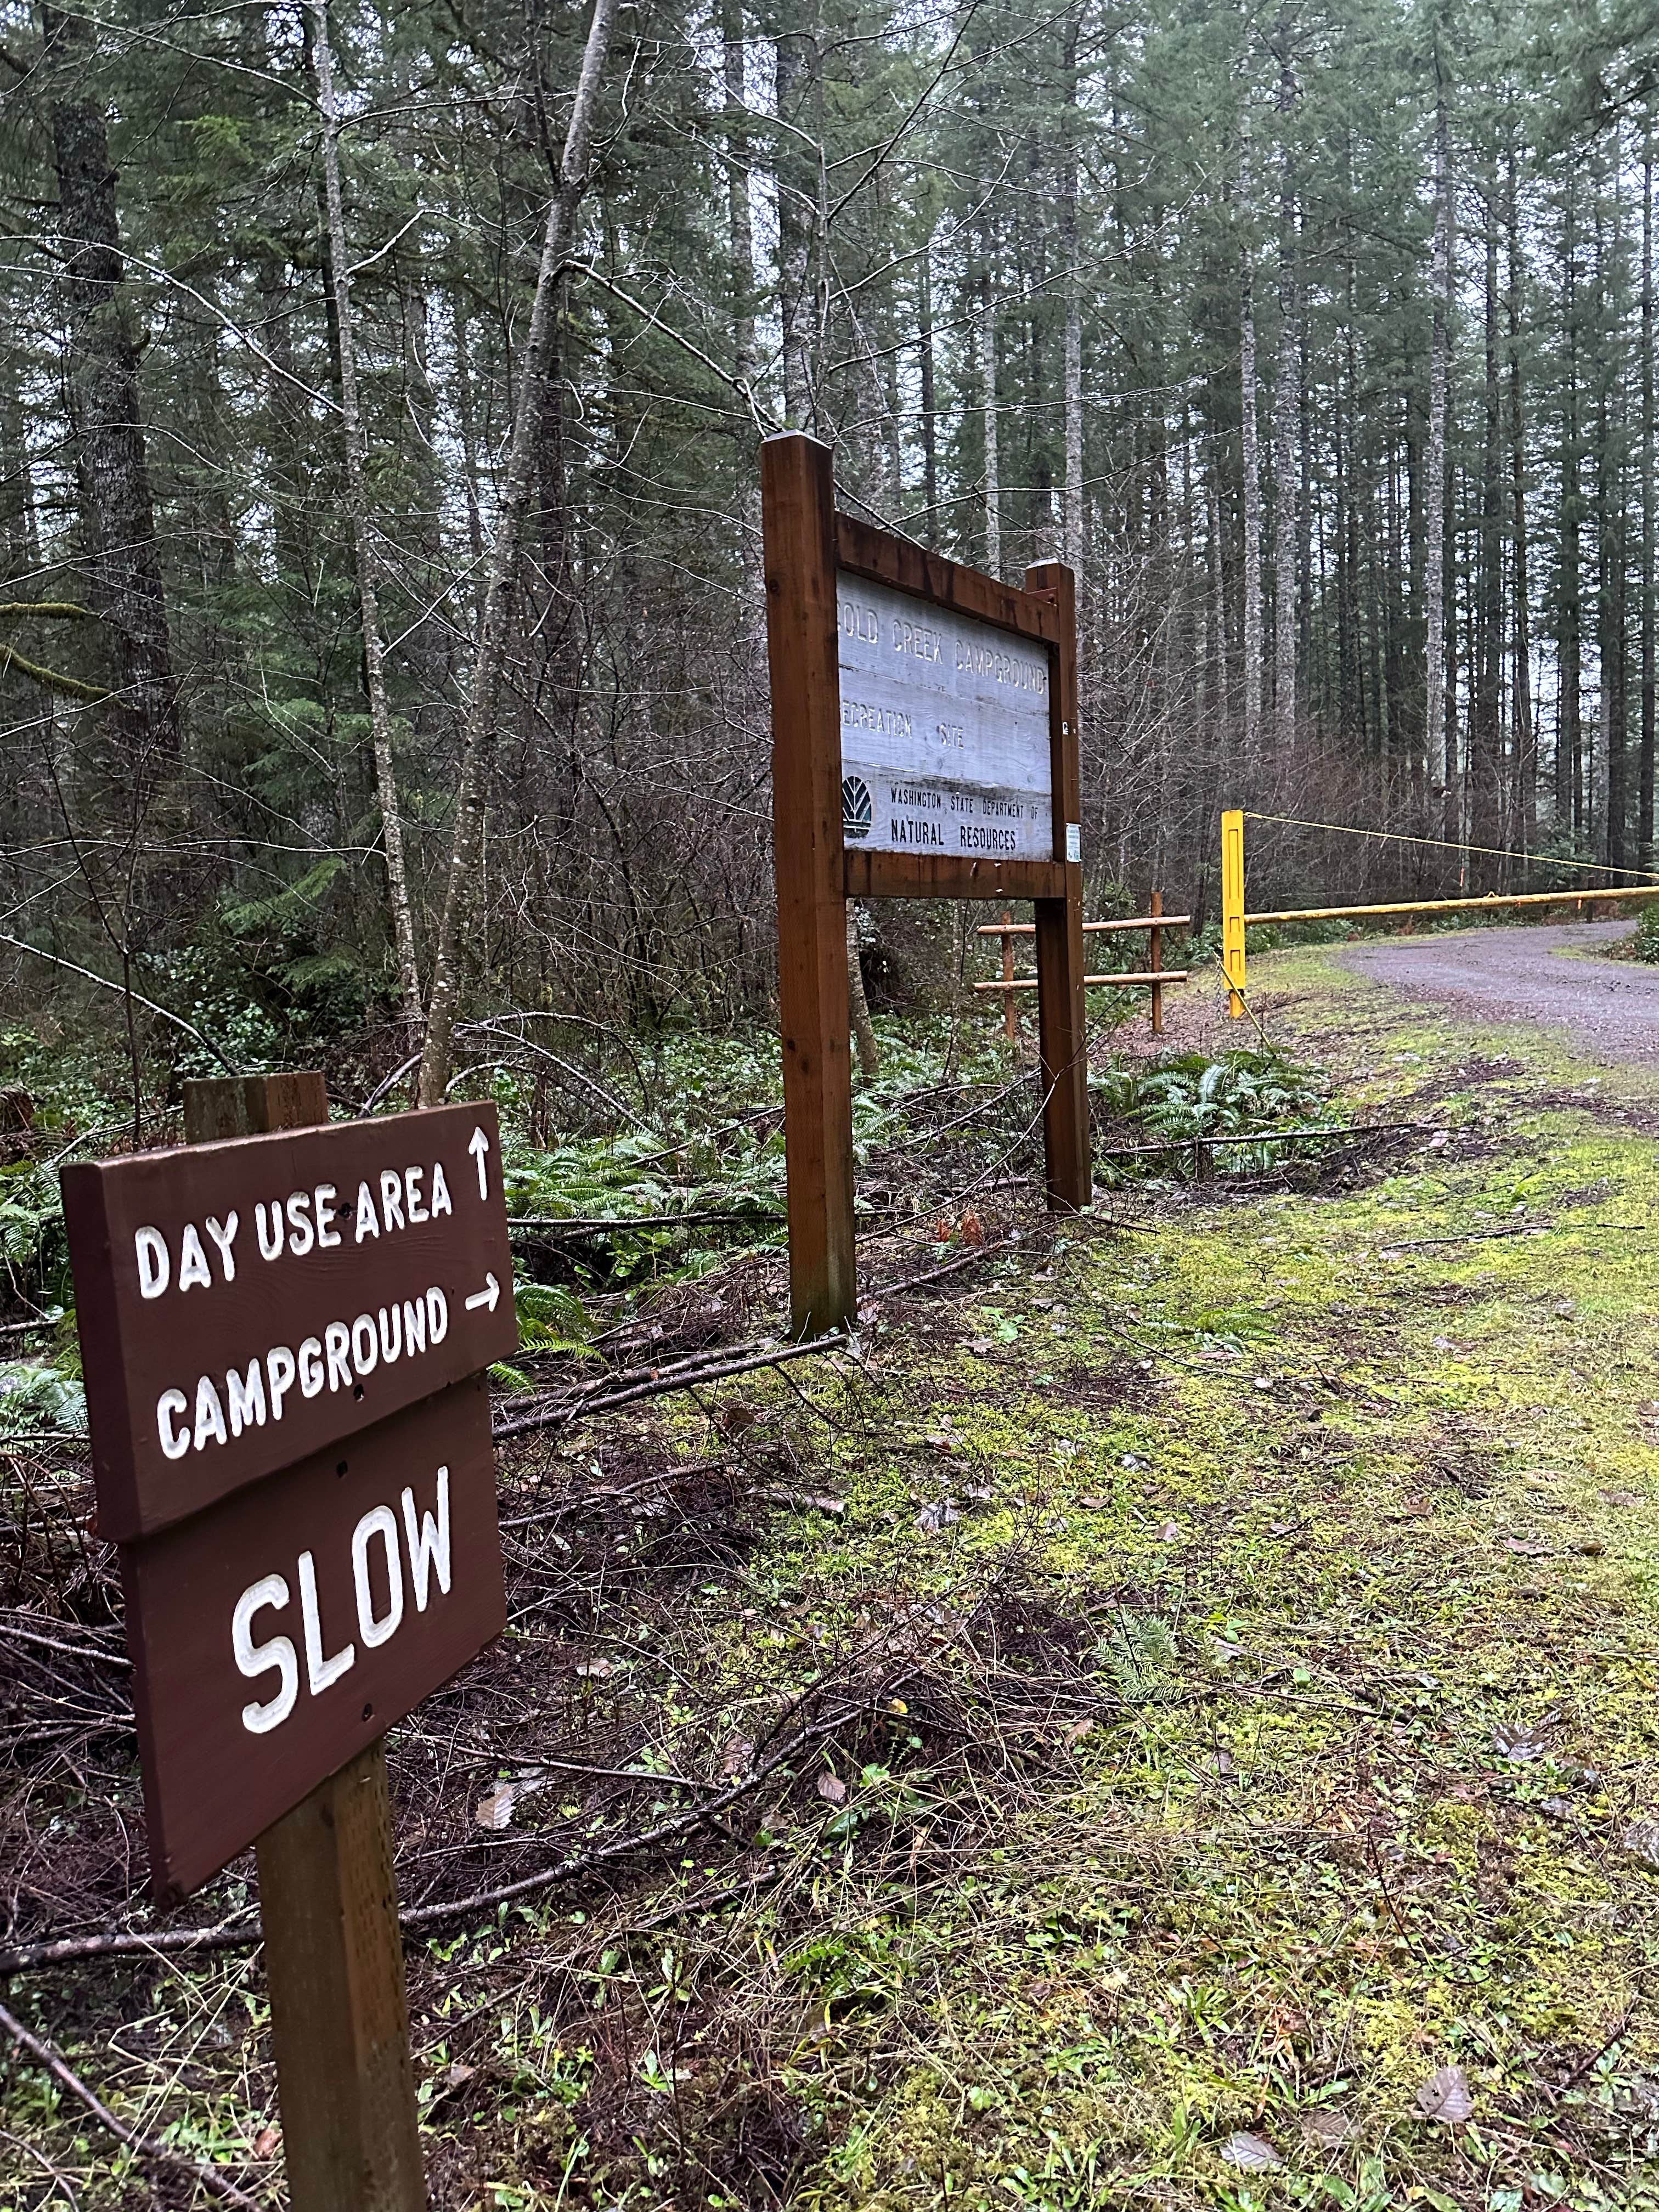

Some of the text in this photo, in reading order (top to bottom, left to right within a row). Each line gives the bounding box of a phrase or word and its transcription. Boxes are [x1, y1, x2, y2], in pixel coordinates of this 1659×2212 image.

[838, 600, 1047, 695] OLD CREEK CAMPGROUND
[842, 699, 964, 749] ECREATION SITE
[890, 787, 1039, 820] WASHINGTON STATE DEPARTMENT OF
[891, 819, 1016, 851] NATURAL RESOURCES
[134, 1162, 453, 1299] DAY USE AREA
[157, 1286, 448, 1460] CAMPGROUND
[232, 1465, 452, 1734] SLOW
